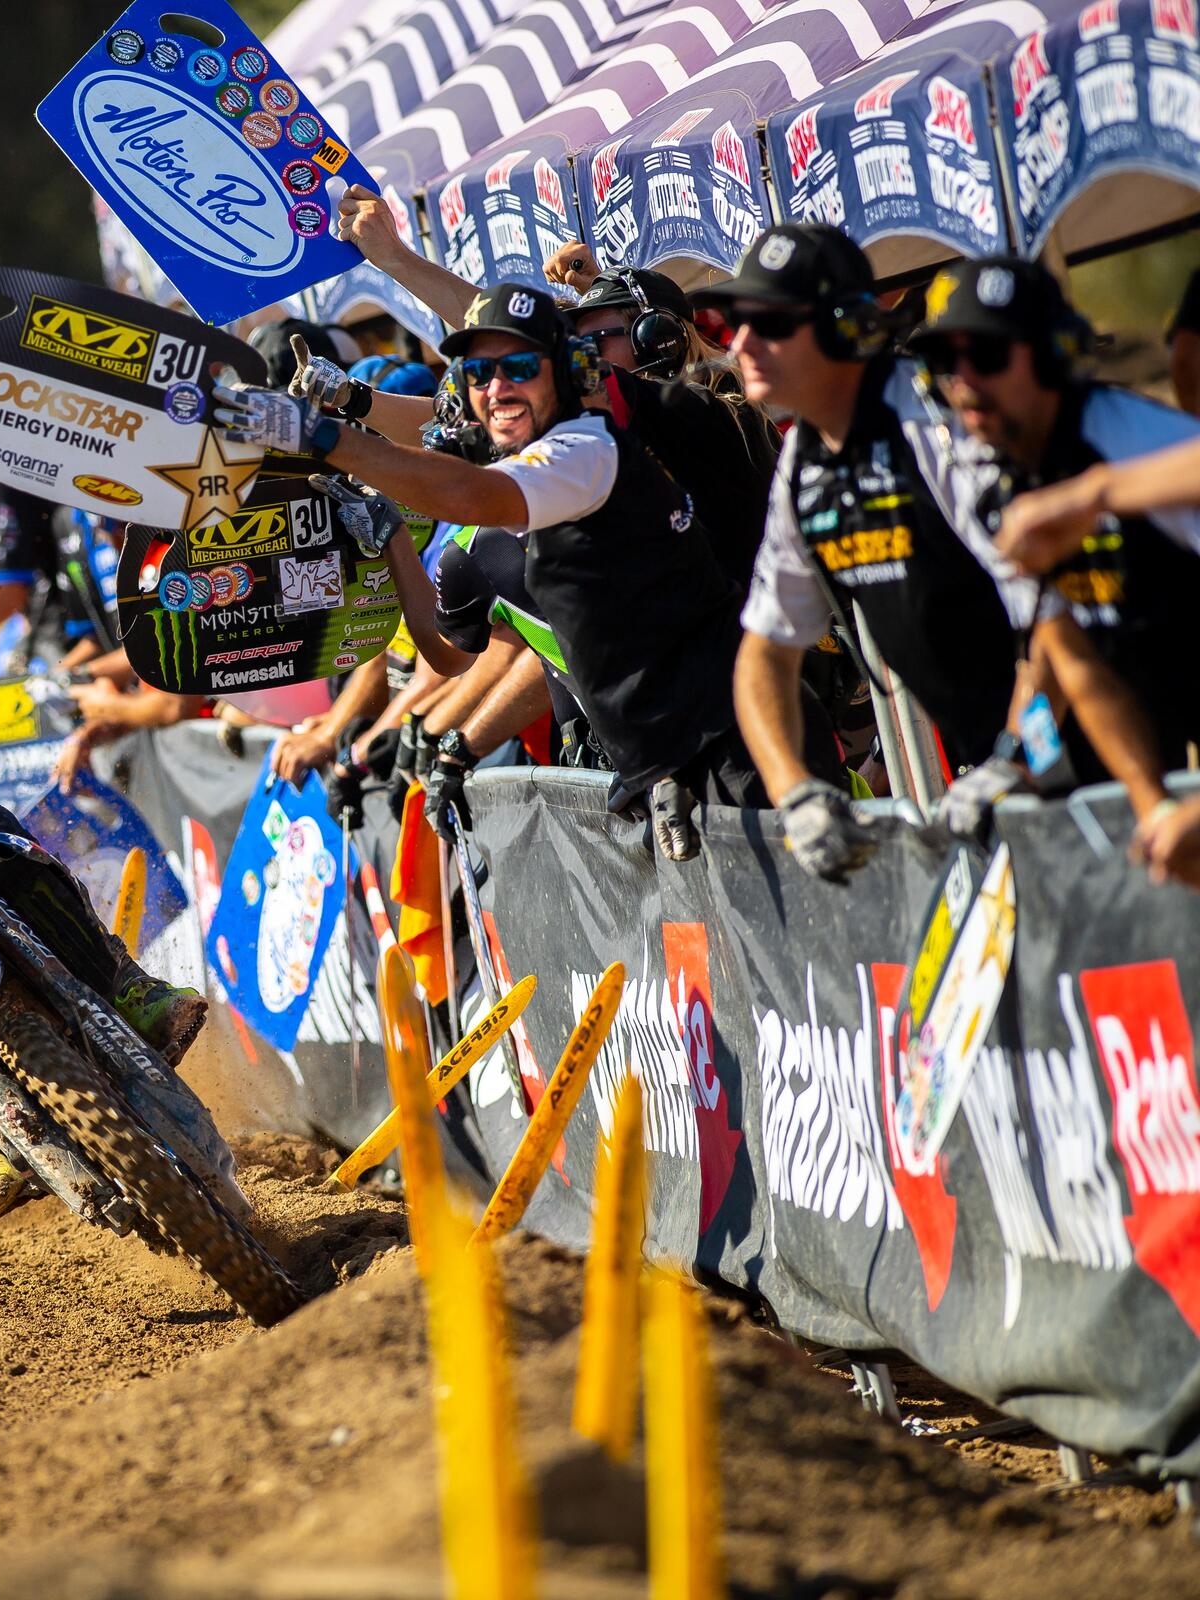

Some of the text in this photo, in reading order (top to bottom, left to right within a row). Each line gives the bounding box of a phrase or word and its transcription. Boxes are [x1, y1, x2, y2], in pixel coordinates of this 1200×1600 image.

[316, 142, 341, 165] MD
[93, 104, 275, 239] Motion Pro
[652, 223, 705, 244] CHAMPIONSHIP
[26, 330, 144, 380] MECHANIX WEAR
[153, 342, 199, 384] 30
[55, 421, 117, 458] DRINK
[74, 475, 142, 504] FMF
[294, 496, 328, 543] 30
[191, 536, 288, 564] MECHANIX WEAR
[200, 603, 290, 631] MONSTE
[359, 605, 399, 617] DUNLOP
[217, 624, 286, 642] ENERGY
[352, 620, 390, 632] SCOTT
[204, 641, 303, 666] PRO CIRCUIT
[336, 656, 356, 665] BELL
[211, 660, 295, 688] Kawasaki
[438, 1004, 510, 1082] ACERBIS
[551, 1003, 604, 1110] ACERBIS
